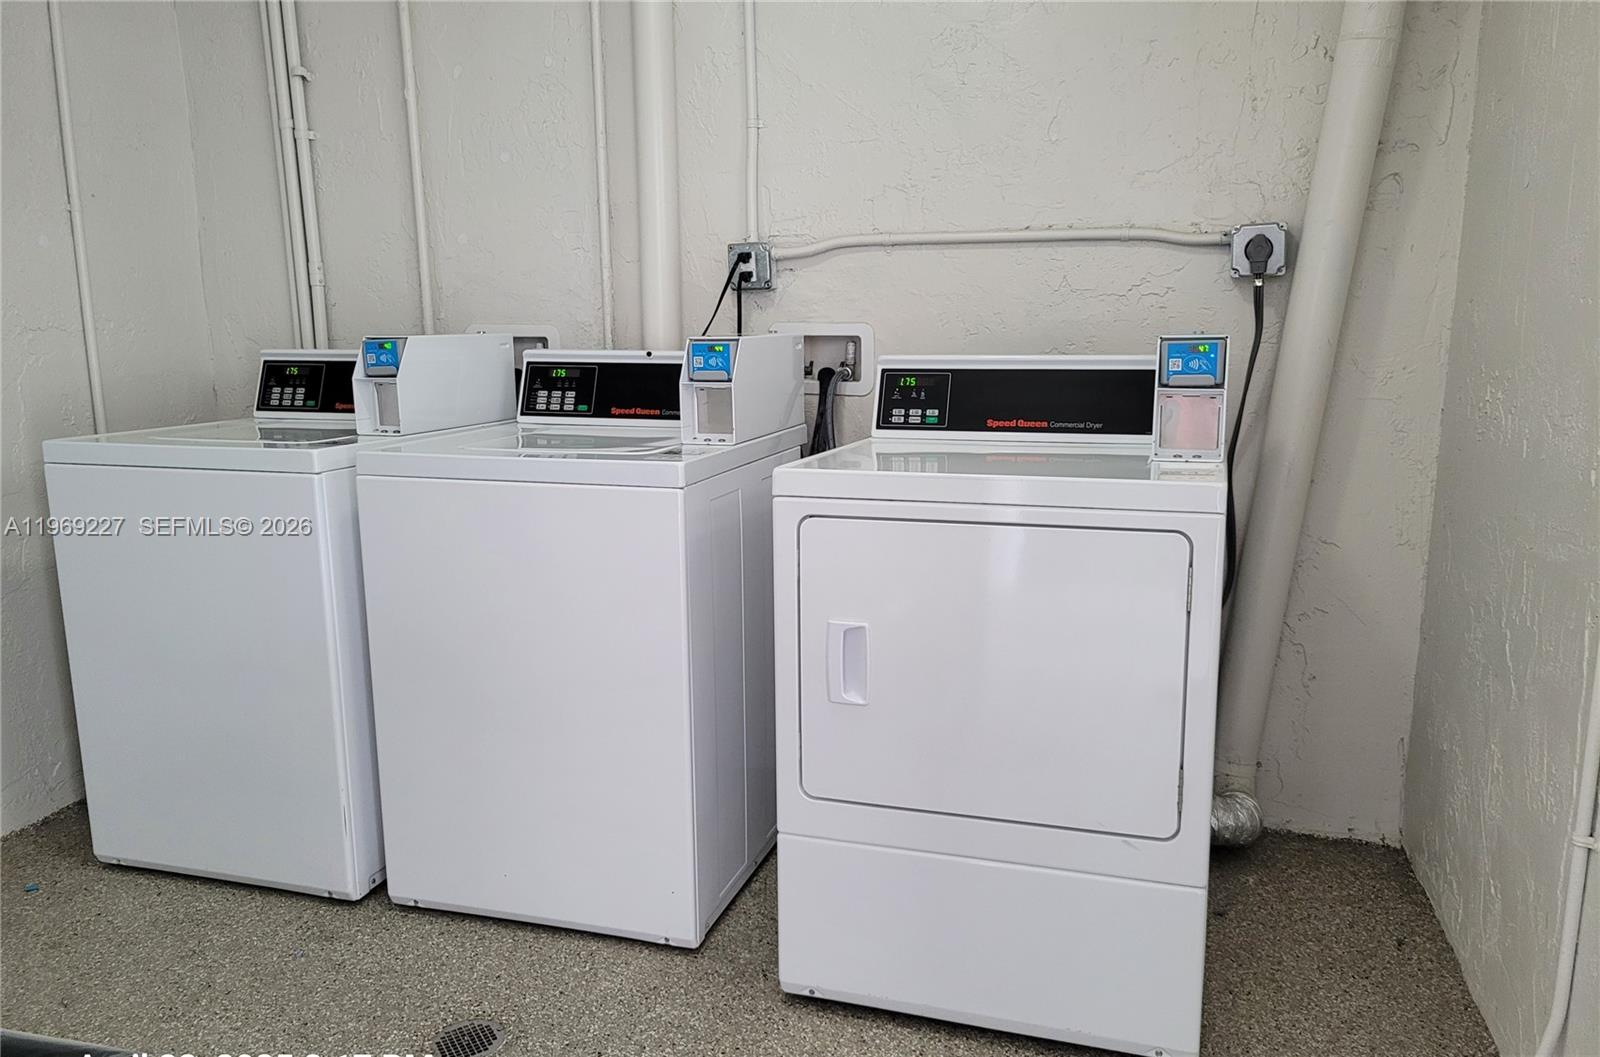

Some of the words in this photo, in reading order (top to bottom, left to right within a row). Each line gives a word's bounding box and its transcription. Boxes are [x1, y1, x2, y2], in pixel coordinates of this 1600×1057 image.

[610, 407, 635, 416] Speed
[986, 419, 1016, 428] Speed
[1017, 420, 1048, 428] Queen
[1086, 422, 1103, 430] Dryer
